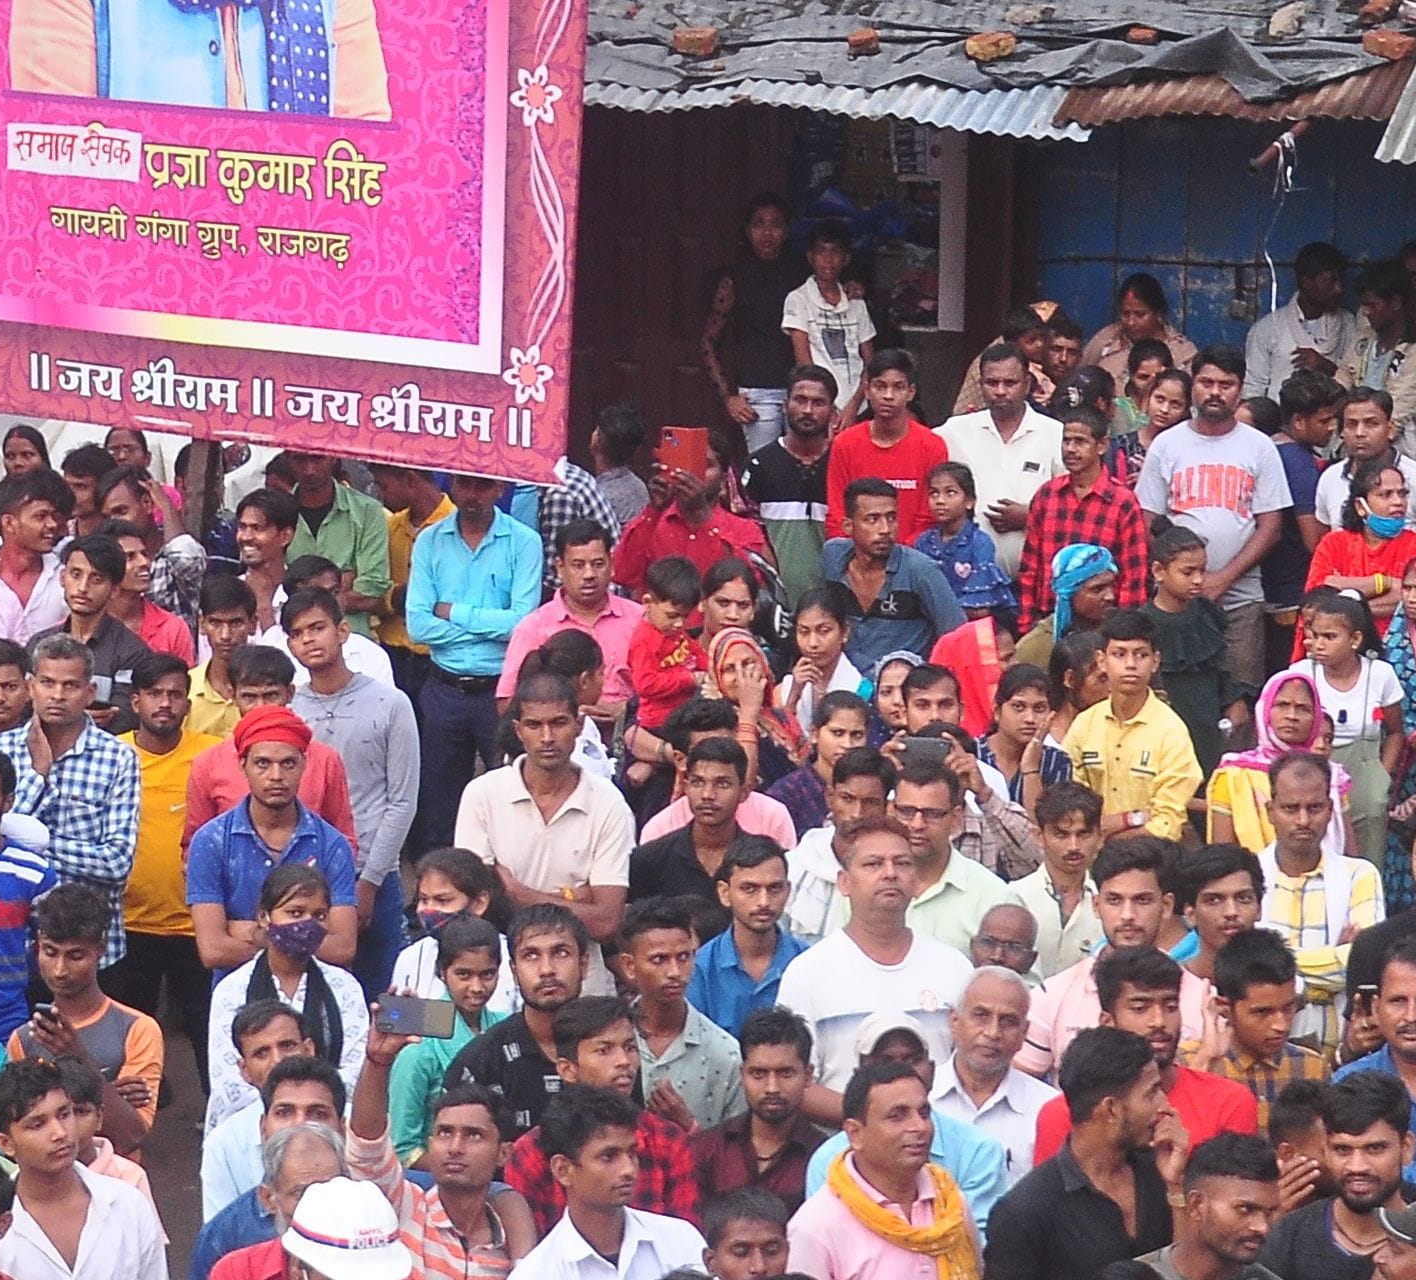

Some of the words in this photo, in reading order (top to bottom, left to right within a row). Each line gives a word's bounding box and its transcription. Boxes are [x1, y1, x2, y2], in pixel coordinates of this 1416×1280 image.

[144, 142, 208, 191] प्रज्ञा
[217, 147, 314, 205] कुमार
[324, 138, 387, 206] सिंह
[50, 204, 128, 242] गायत्री
[135, 212, 188, 247] गंगा
[258, 225, 351, 270] राजगढ़
[56, 357, 123, 403] जय
[130, 357, 240, 415] श्रीराम
[284, 382, 360, 428] जय
[368, 382, 493, 443] श्रीराम
